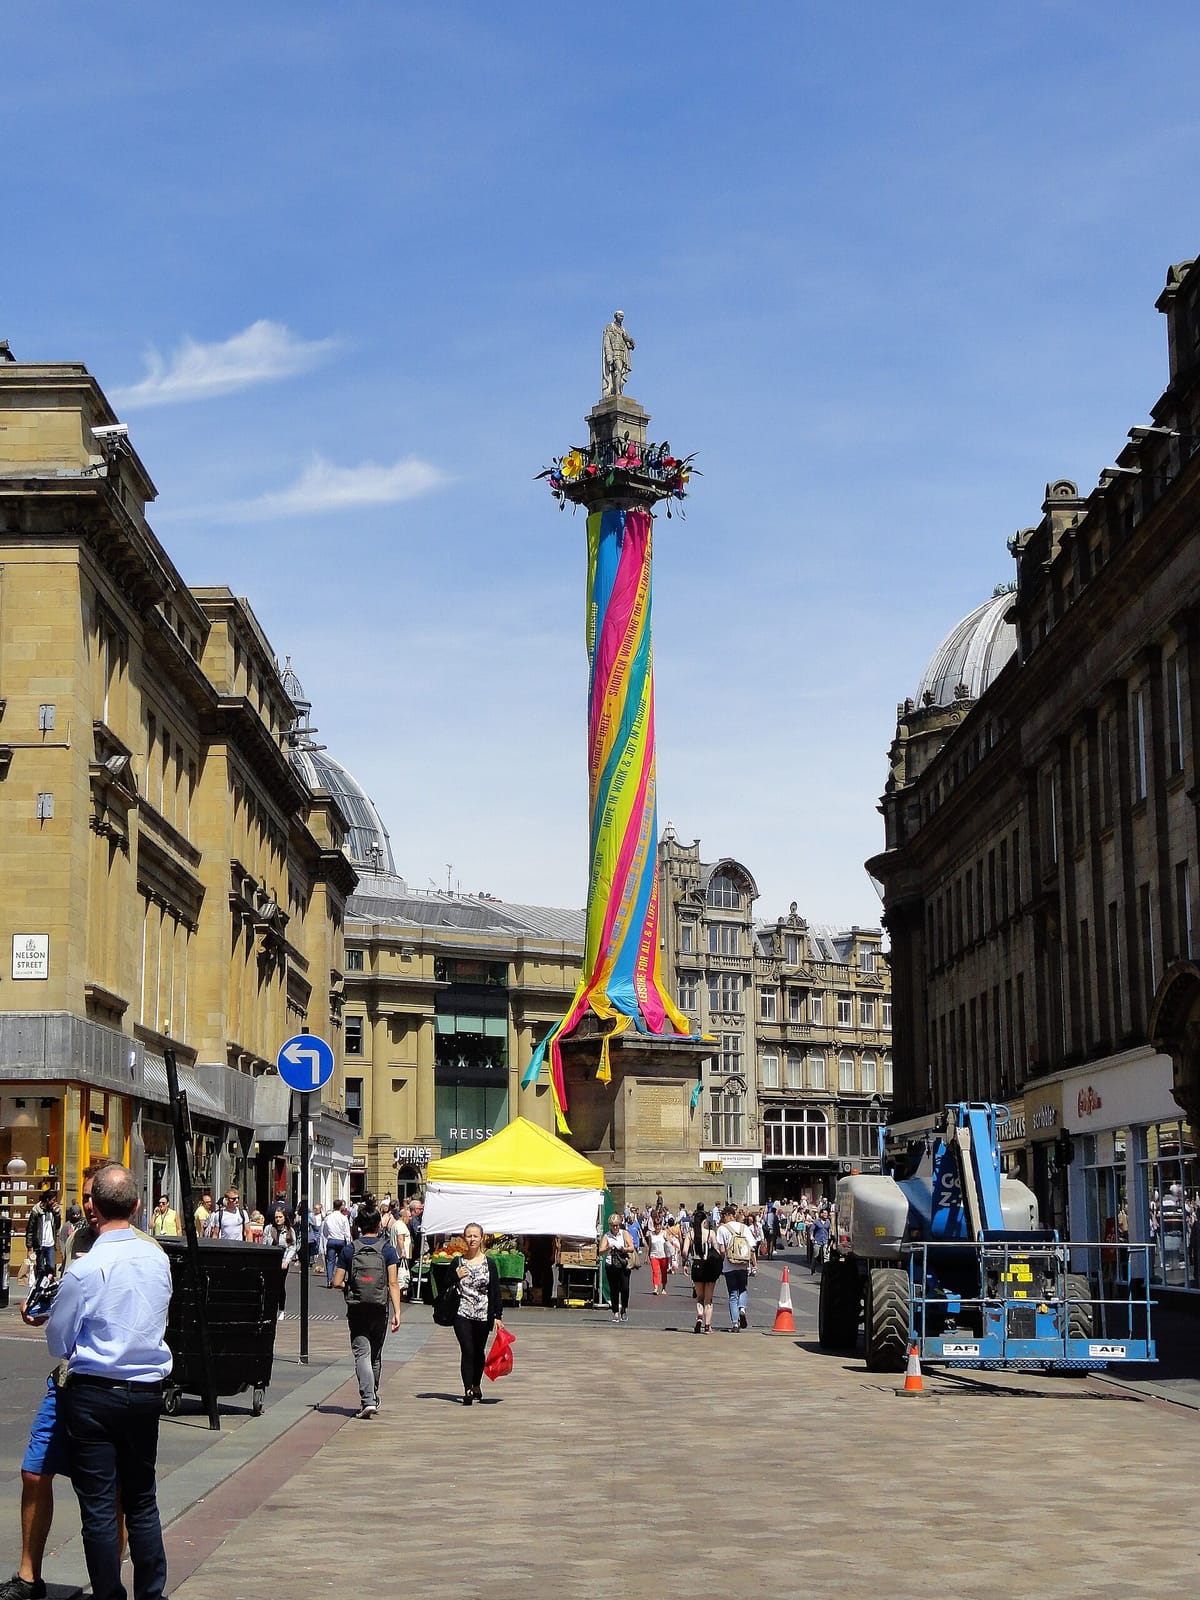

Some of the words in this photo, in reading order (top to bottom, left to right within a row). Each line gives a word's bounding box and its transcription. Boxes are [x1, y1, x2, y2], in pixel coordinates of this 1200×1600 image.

[589, 602, 599, 653] OWNERSHIP
[592, 740, 604, 770] WORLD
[599, 712, 612, 738] UNITE
[609, 659, 628, 696] SHORTEN
[619, 619, 640, 657] WORKING
[633, 601, 643, 617] DAY
[638, 593, 645, 601] &
[633, 698, 647, 729] LEISURE
[629, 729, 640, 740] IN
[624, 741, 638, 758] JOY
[621, 760, 632, 768] &
[612, 768, 629, 793] WORK
[608, 794, 619, 805] IN
[602, 806, 616, 828] HOPE
[595, 851, 604, 867] DAY
[647, 901, 656, 920] LIFE
[645, 921, 654, 929] A
[644, 930, 653, 938] &
[641, 939, 651, 954] ALL
[17, 961, 44, 969] STREET
[637, 955, 649, 972] FOR
[636, 973, 648, 1003] LEISURE
[449, 1128, 493, 1140] REISS
